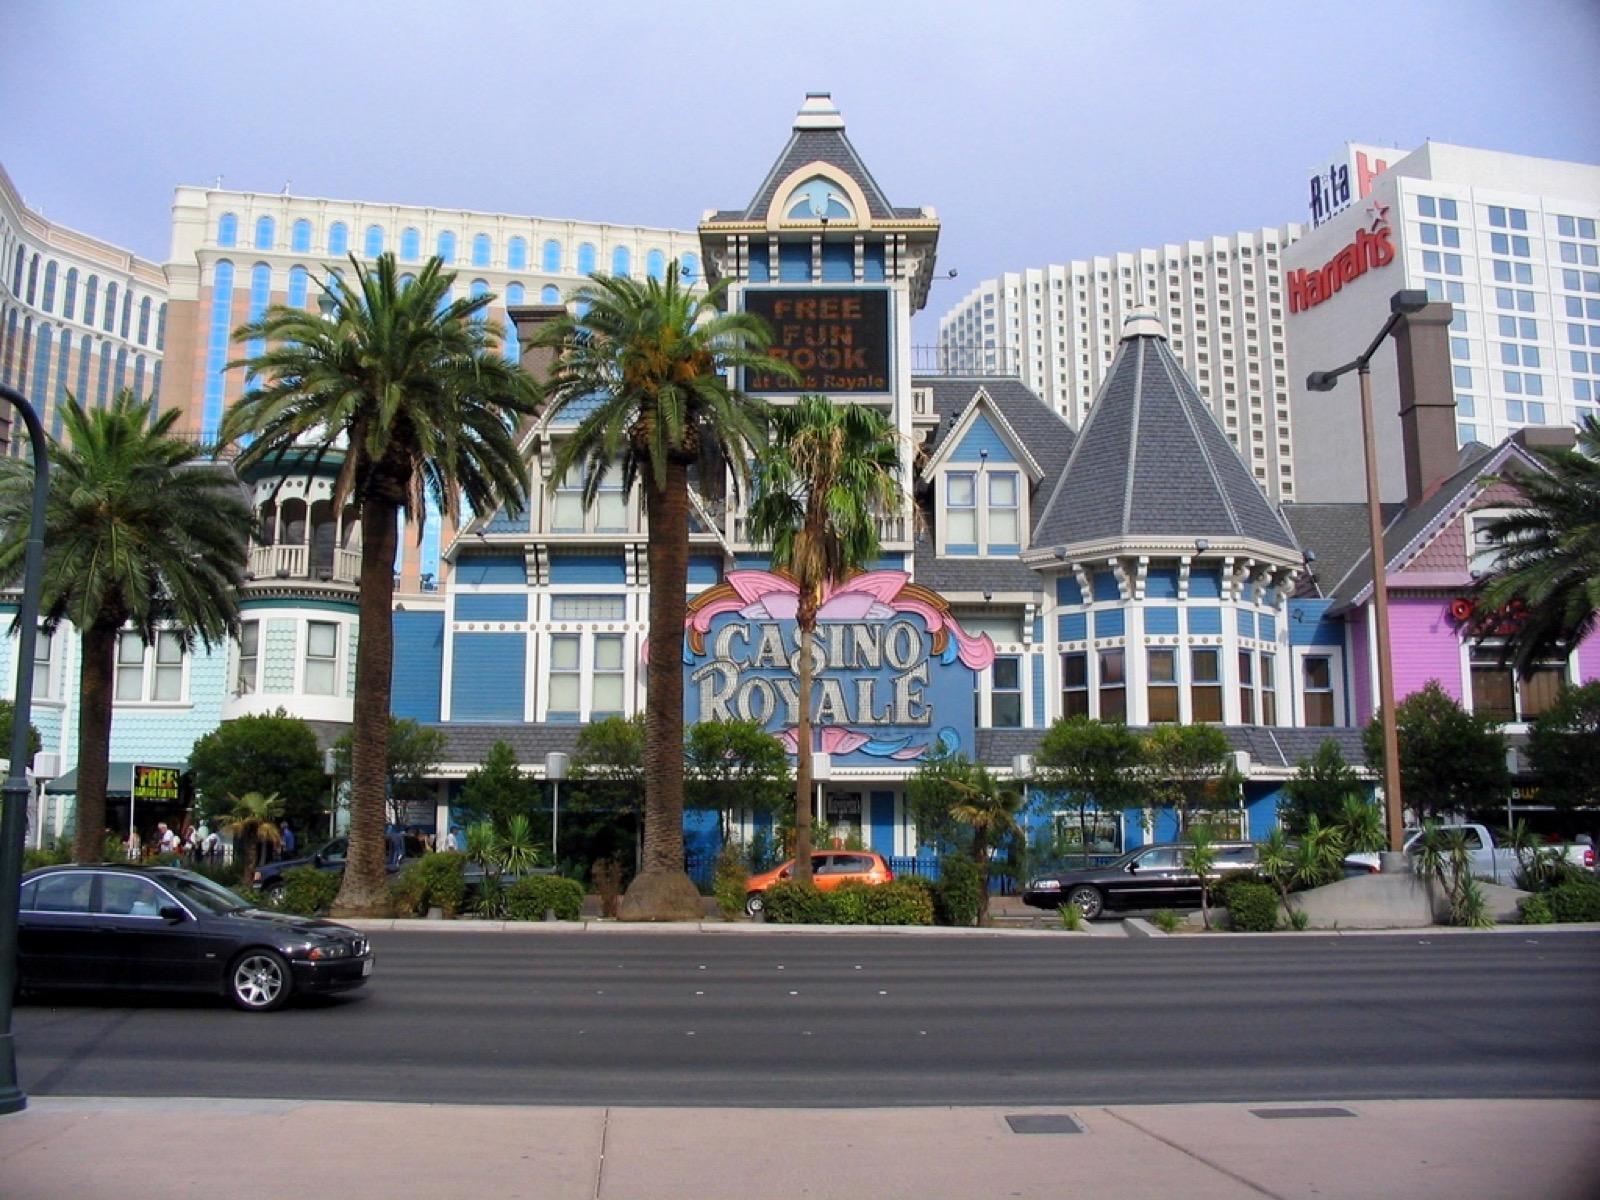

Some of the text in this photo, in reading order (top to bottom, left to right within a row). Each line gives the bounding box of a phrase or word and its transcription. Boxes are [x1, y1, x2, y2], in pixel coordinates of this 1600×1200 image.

[1309, 163, 1350, 221] Rita
[773, 298, 861, 320] FREE
[782, 322, 854, 346] FUN
[752, 374, 770, 389] at
[823, 373, 885, 391] Royale
[713, 618, 922, 678] CASINO
[690, 657, 932, 728] ROYALE
